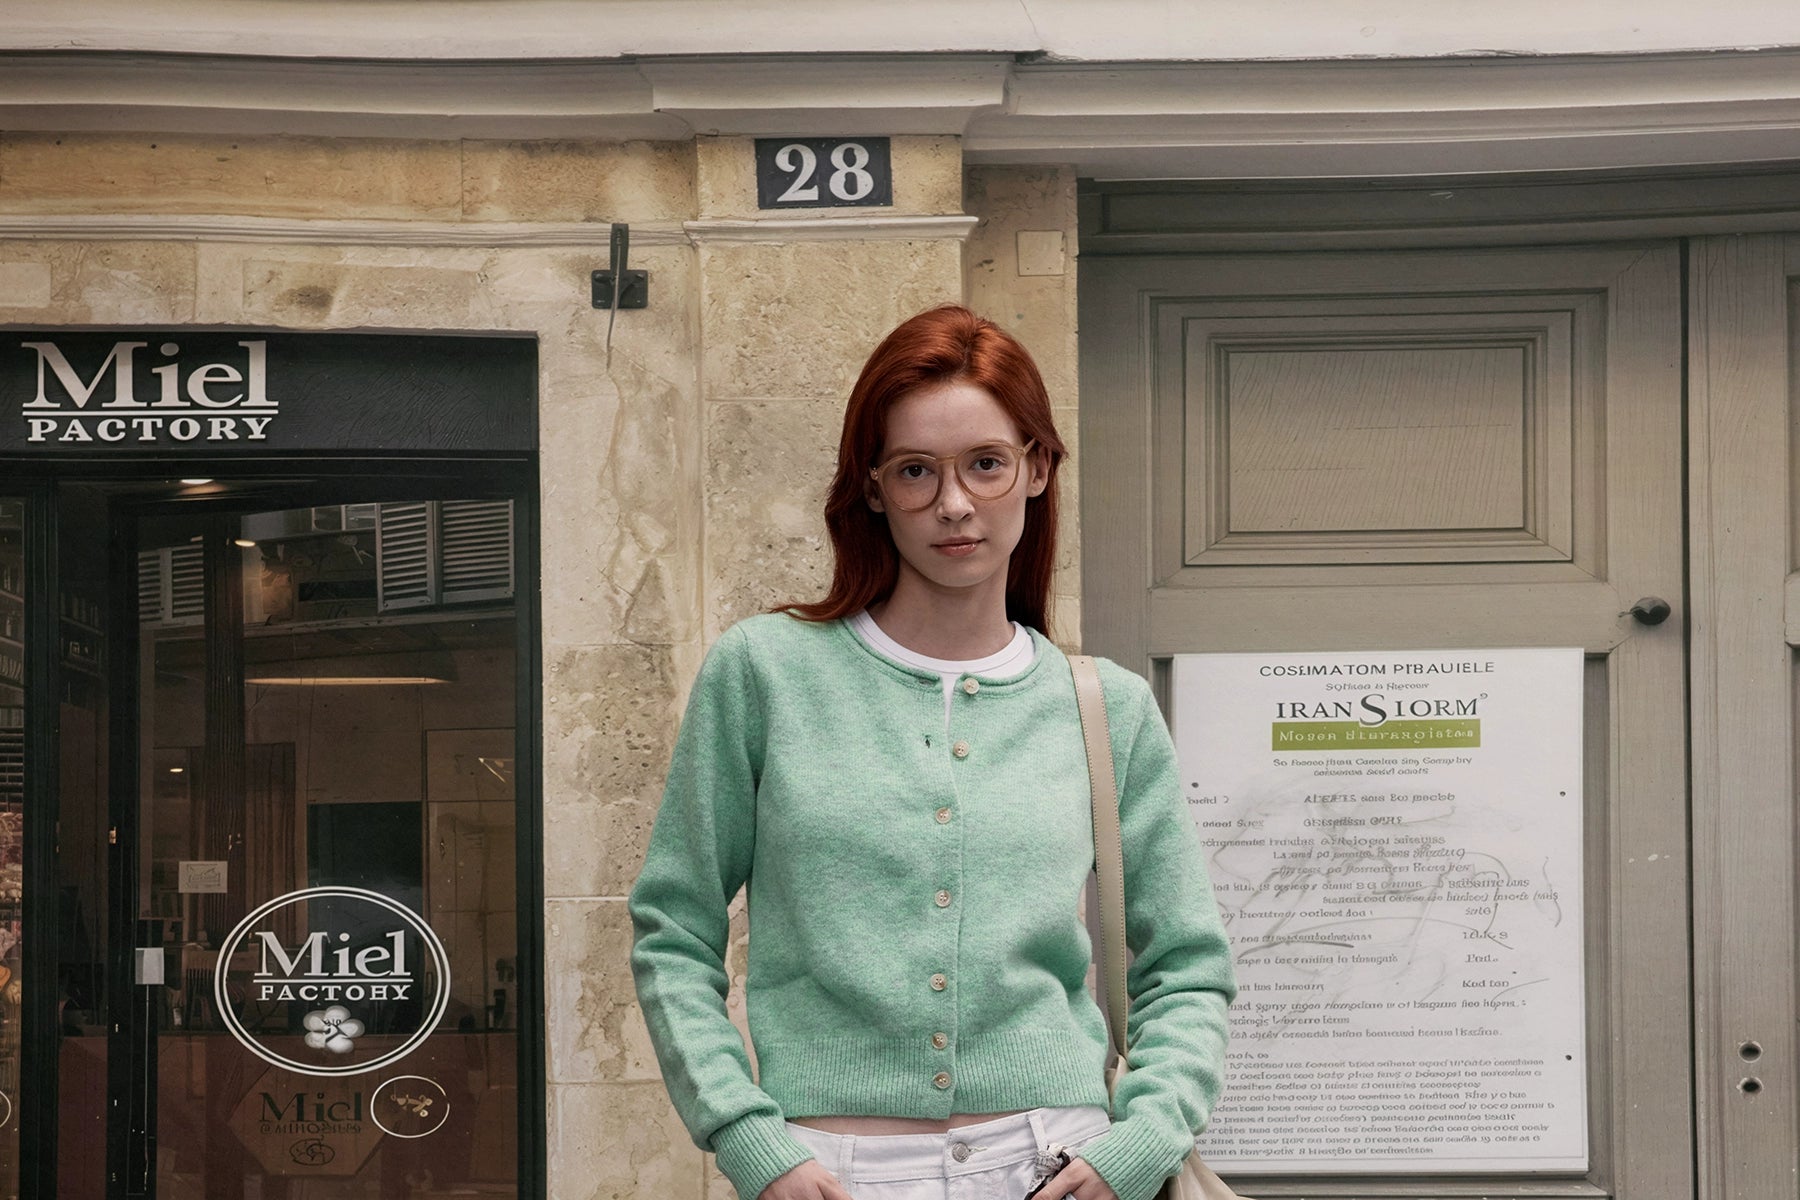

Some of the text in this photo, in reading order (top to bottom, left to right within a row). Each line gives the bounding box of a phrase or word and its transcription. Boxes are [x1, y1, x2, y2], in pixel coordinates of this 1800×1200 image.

[775, 142, 874, 202] 28
[21, 340, 279, 409] Miel
[254, 930, 411, 977] Miel
